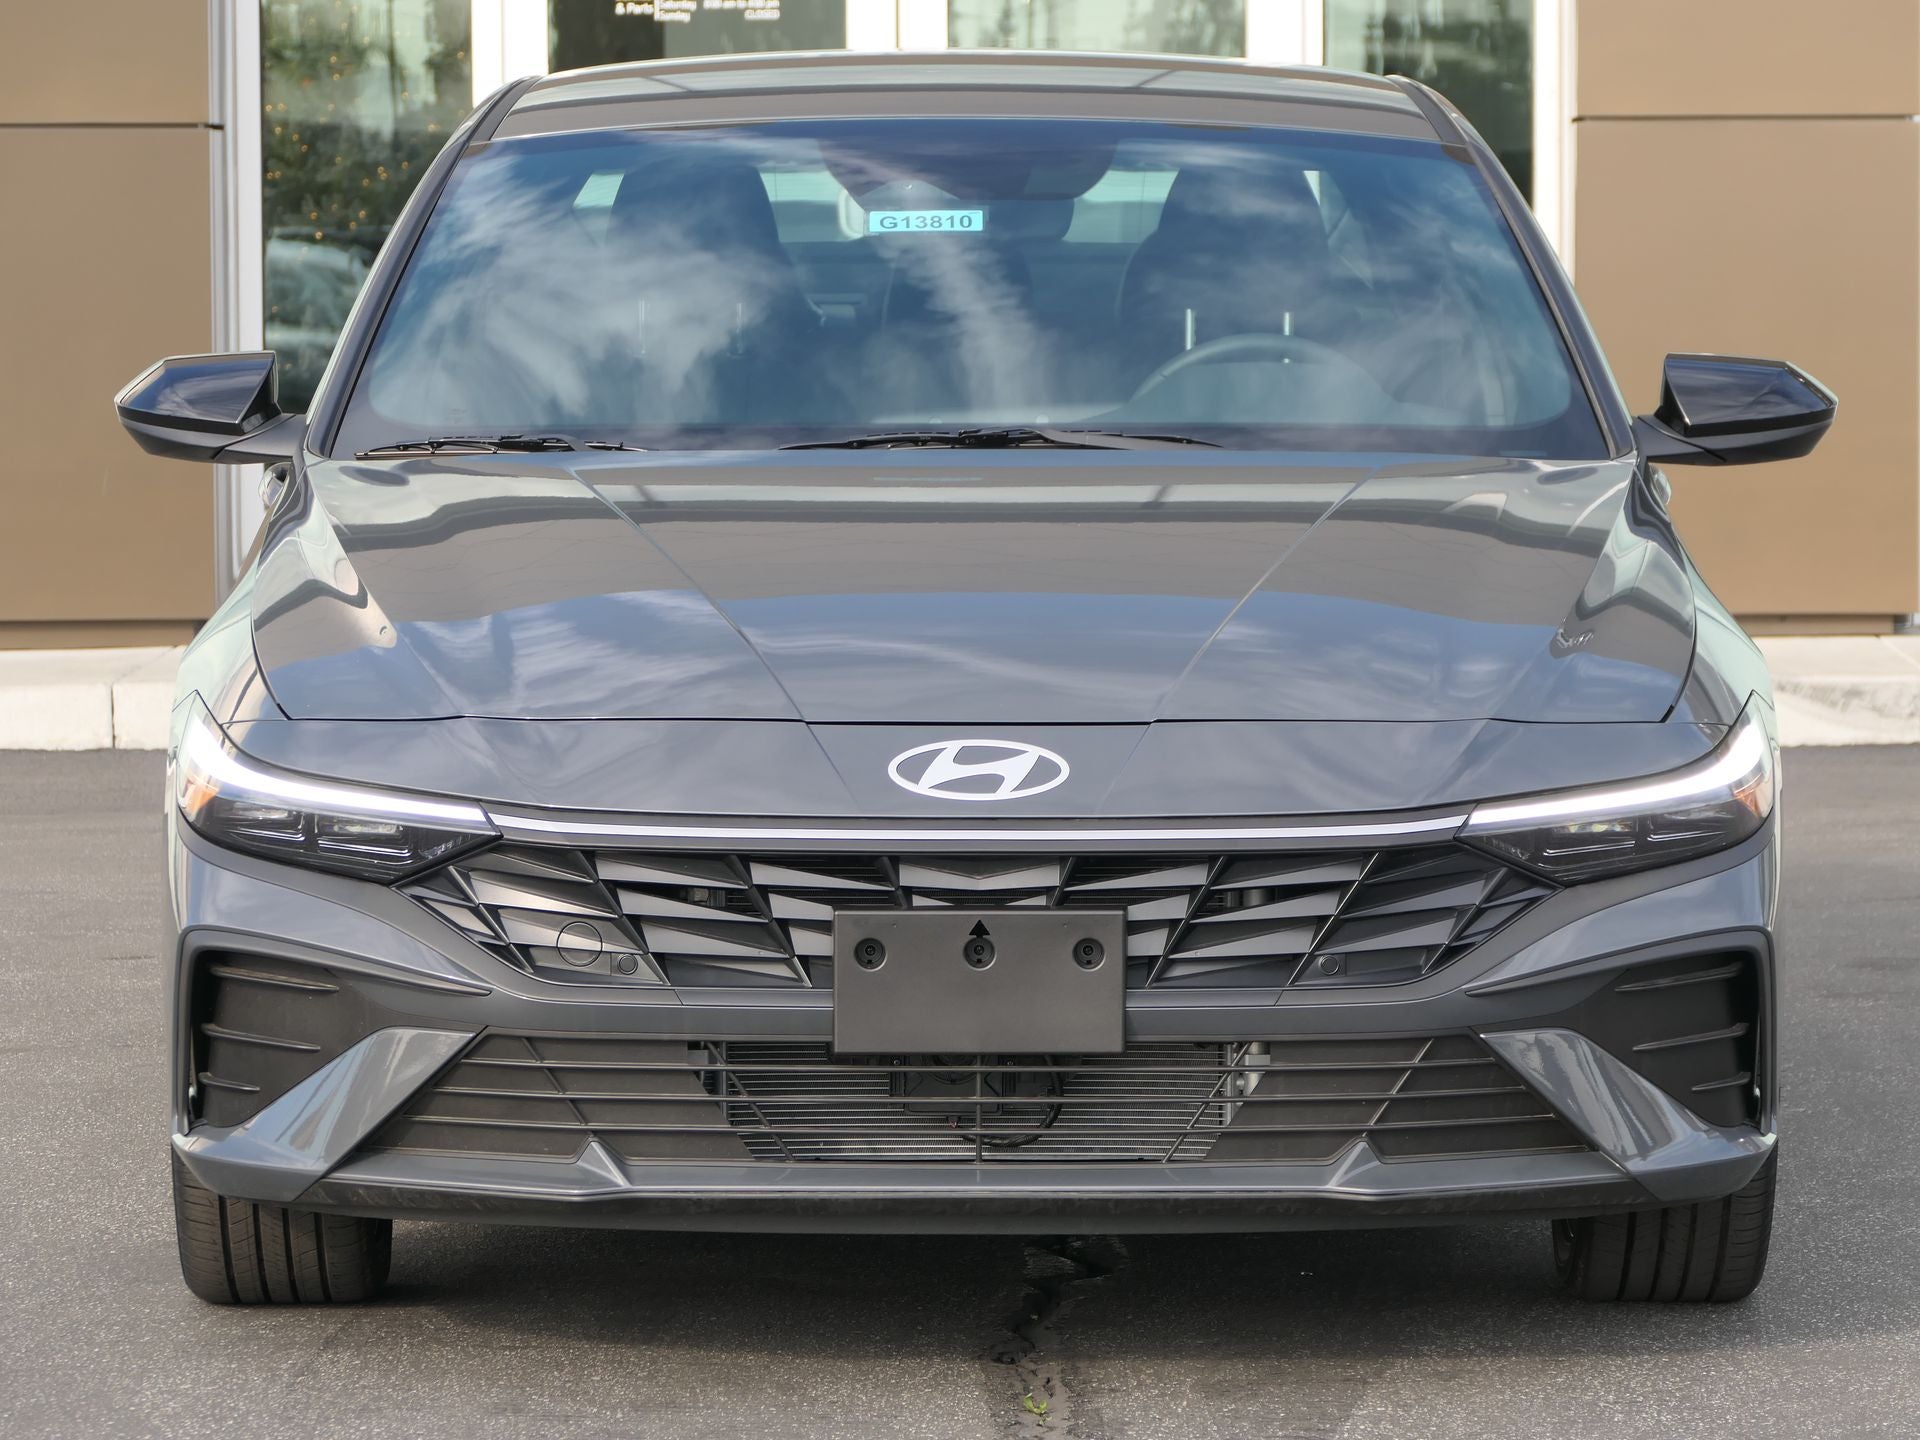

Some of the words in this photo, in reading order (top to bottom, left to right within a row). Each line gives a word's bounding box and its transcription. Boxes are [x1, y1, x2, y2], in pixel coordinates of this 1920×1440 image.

[615, 2, 625, 15] &
[626, 2, 653, 15] Parts
[660, 11, 691, 23] Sunday
[744, 9, 780, 20] CLOSED
[879, 215, 973, 229] G13810
